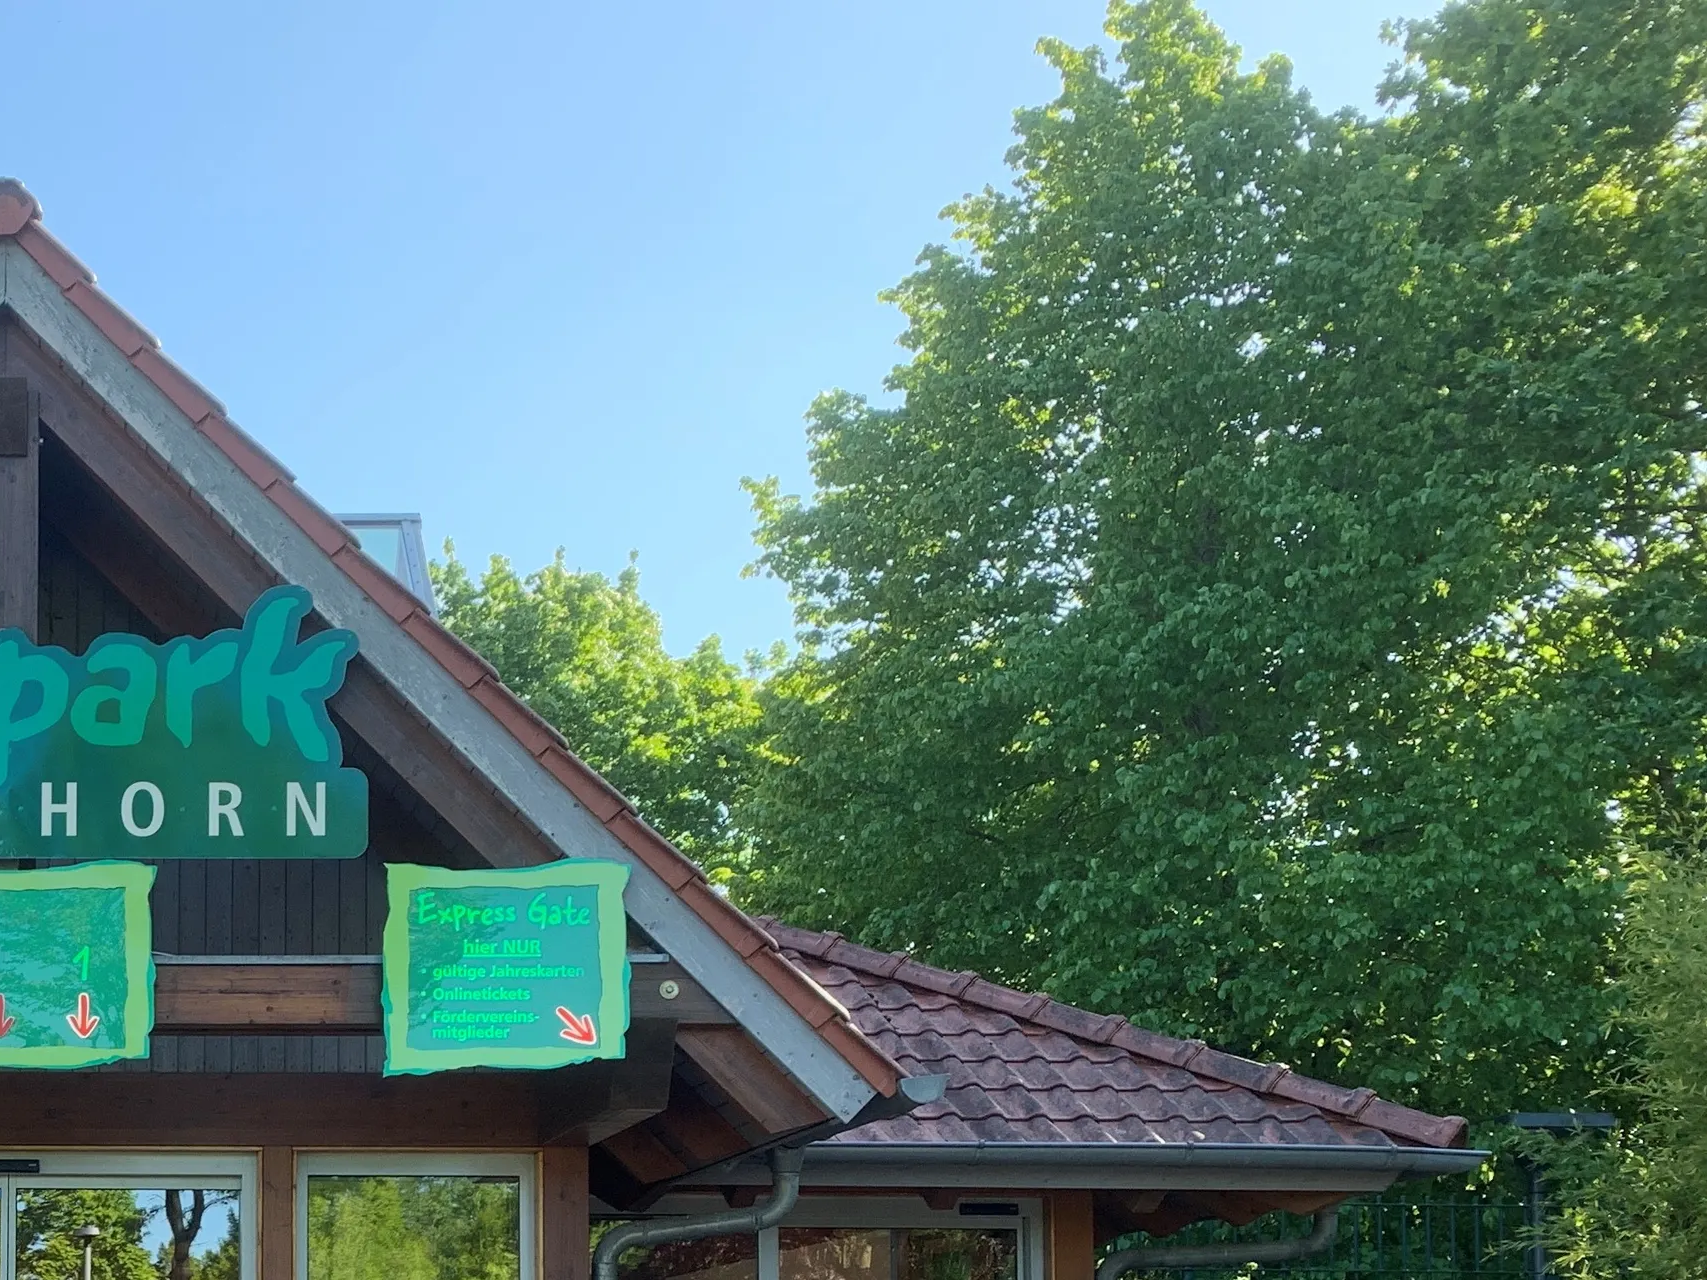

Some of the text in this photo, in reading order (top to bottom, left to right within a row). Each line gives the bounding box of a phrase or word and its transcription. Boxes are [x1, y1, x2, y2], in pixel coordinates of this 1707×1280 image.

[417, 891, 590, 931] Express Gate
[463, 938, 541, 954] hier NUR
[72, 945, 90, 981] 1
[432, 964, 585, 981] gültige Jahreskarten
[432, 987, 531, 1001] Onlinetickets
[432, 1009, 541, 1024] Fördervereins-
[432, 1025, 510, 1042] mitglieder
